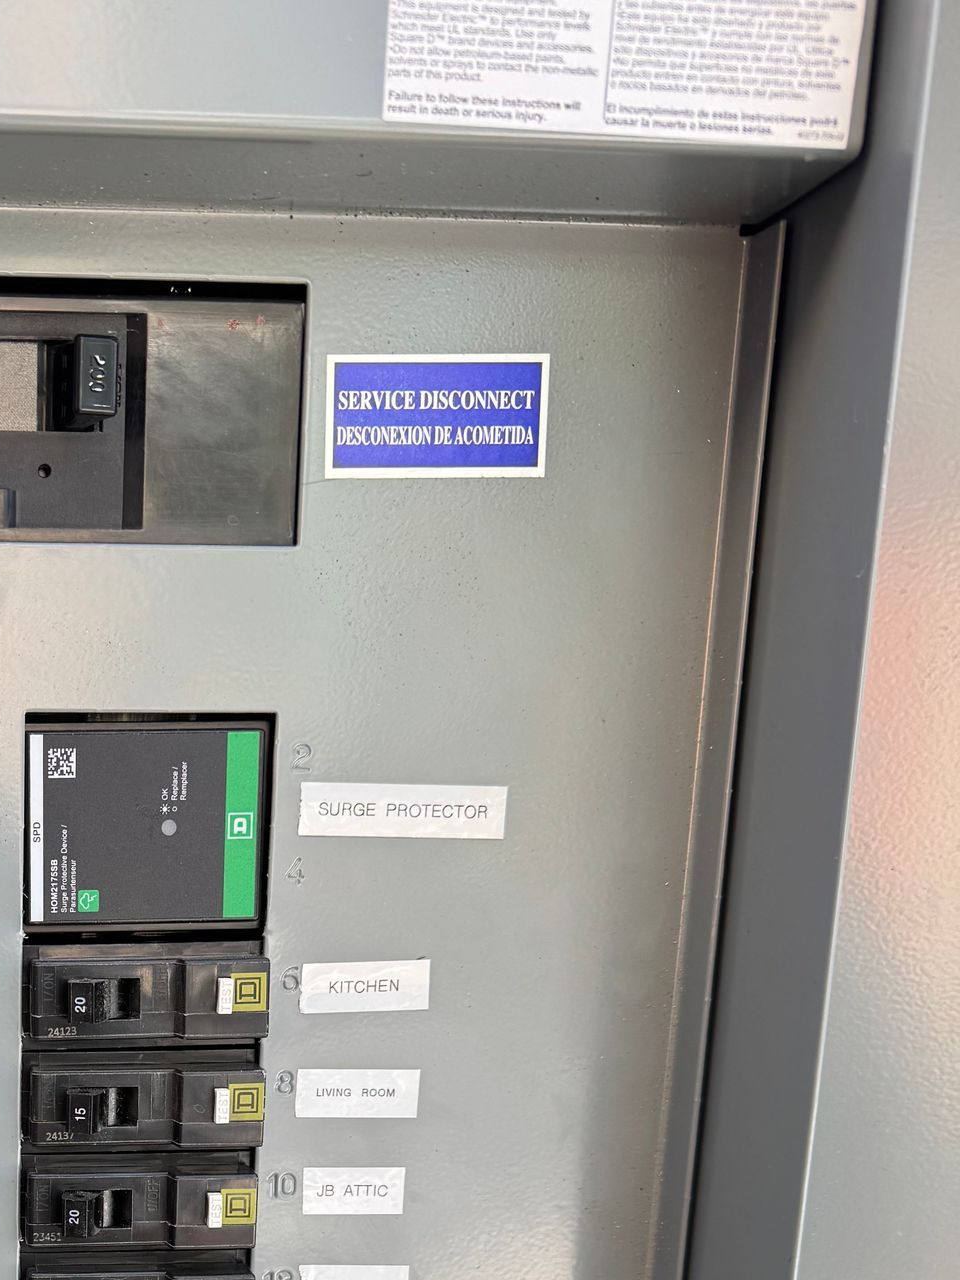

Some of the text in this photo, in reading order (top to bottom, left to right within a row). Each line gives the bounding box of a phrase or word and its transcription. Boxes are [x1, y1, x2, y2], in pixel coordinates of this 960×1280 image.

[389, 90, 581, 111] Failure to follow these instructions will
[89, 354, 106, 392] 200
[339, 390, 535, 410] SERVICE DISCONNECT
[337, 425, 533, 445] DESCONEXION DE ACOMETIDA
[291, 743, 312, 774] 2
[171, 773, 179, 800] Replace
[180, 761, 188, 801] Remplacer
[162, 788, 168, 800] OK
[318, 802, 487, 819] SURGE PROTECTOR
[33, 822, 41, 843] SPD
[61, 854, 69, 891] Protective
[285, 856, 304, 886] 4
[50, 859, 59, 913] HOM2175SB
[61, 893, 69, 913] Surge
[280, 966, 300, 993] 6
[328, 979, 400, 994] KITCHEN
[75, 997, 85, 1012] 20
[220, 981, 232, 1012] TEST
[48, 1027, 77, 1037] 24123
[274, 1069, 294, 1096] 8
[316, 1088, 395, 1097] LIVING ROOM
[75, 1107, 86, 1121] 15
[218, 1092, 228, 1122] TEST
[266, 1172, 297, 1199] 10
[317, 1185, 388, 1197] JB ATTIC
[69, 1209, 80, 1224] 20
[210, 1194, 221, 1227] TEST
[33, 1233, 61, 1241] 23451
